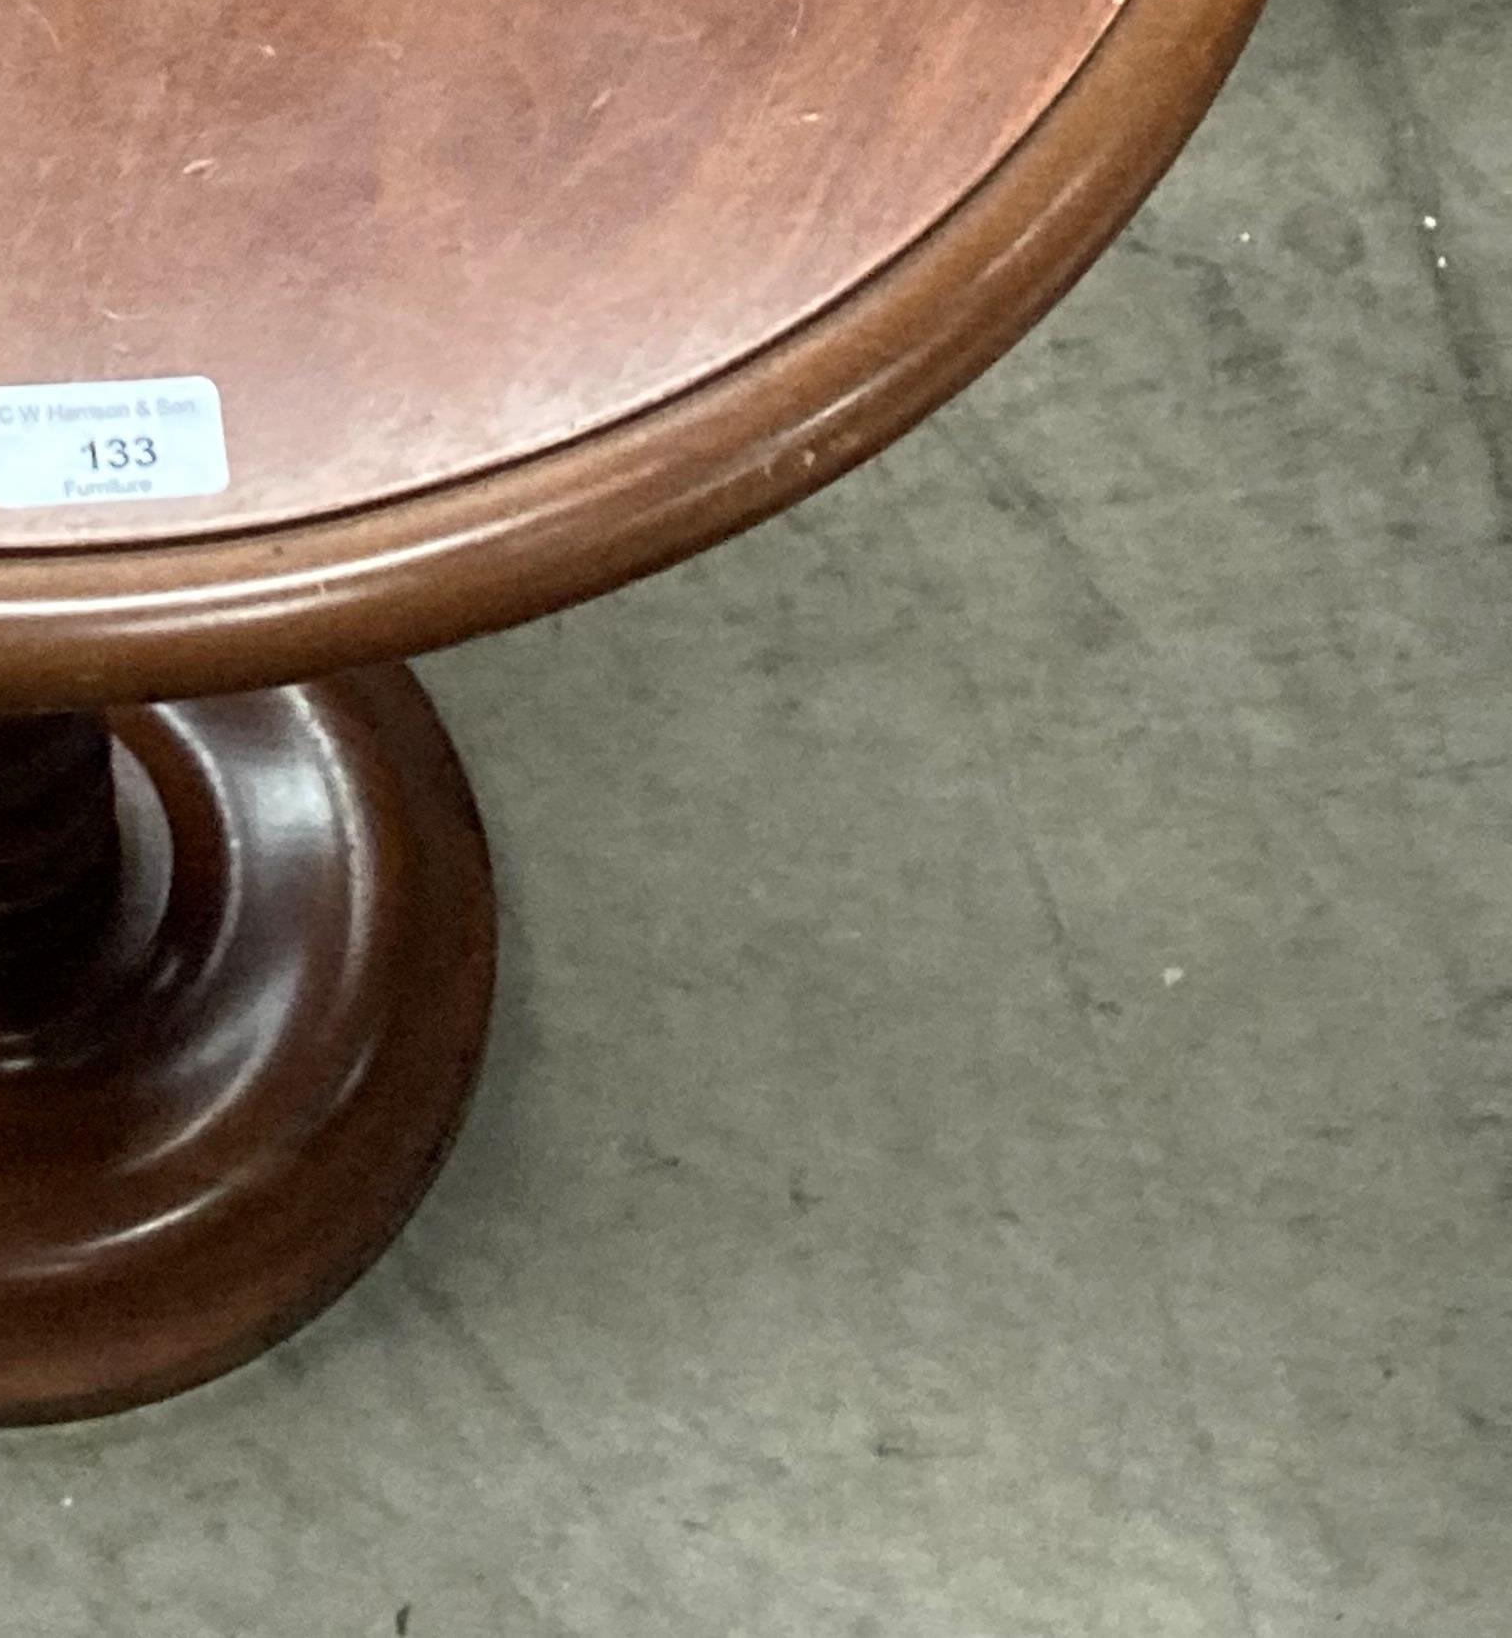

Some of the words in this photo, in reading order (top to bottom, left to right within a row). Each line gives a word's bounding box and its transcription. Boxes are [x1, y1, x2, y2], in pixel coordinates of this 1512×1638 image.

[18, 404, 40, 423] W
[135, 399, 151, 417] &
[80, 436, 159, 471] 133
[63, 478, 153, 497] Furniture
